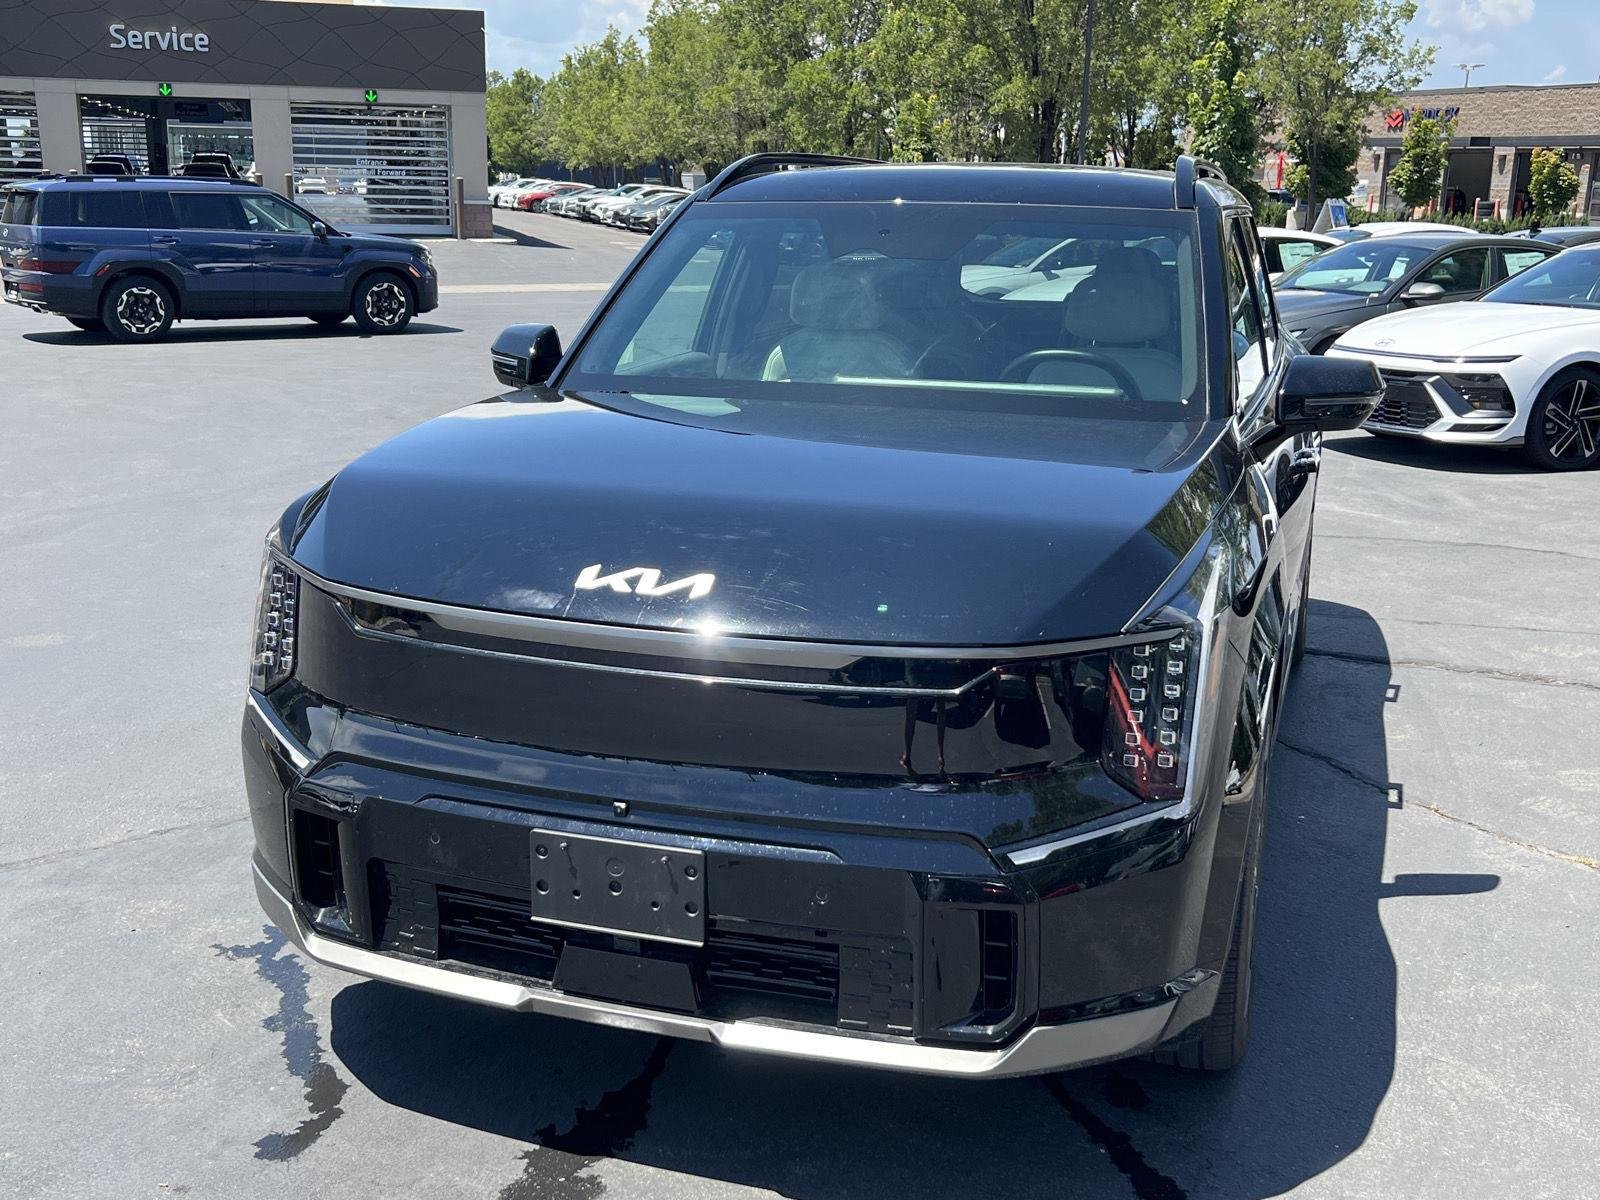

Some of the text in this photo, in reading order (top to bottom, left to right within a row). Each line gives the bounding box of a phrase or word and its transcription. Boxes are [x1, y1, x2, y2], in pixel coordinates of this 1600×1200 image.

[109, 24, 210, 52] Service
[356, 158, 388, 166] Entrance
[377, 168, 406, 176] Forward
[574, 563, 716, 600] KIA
